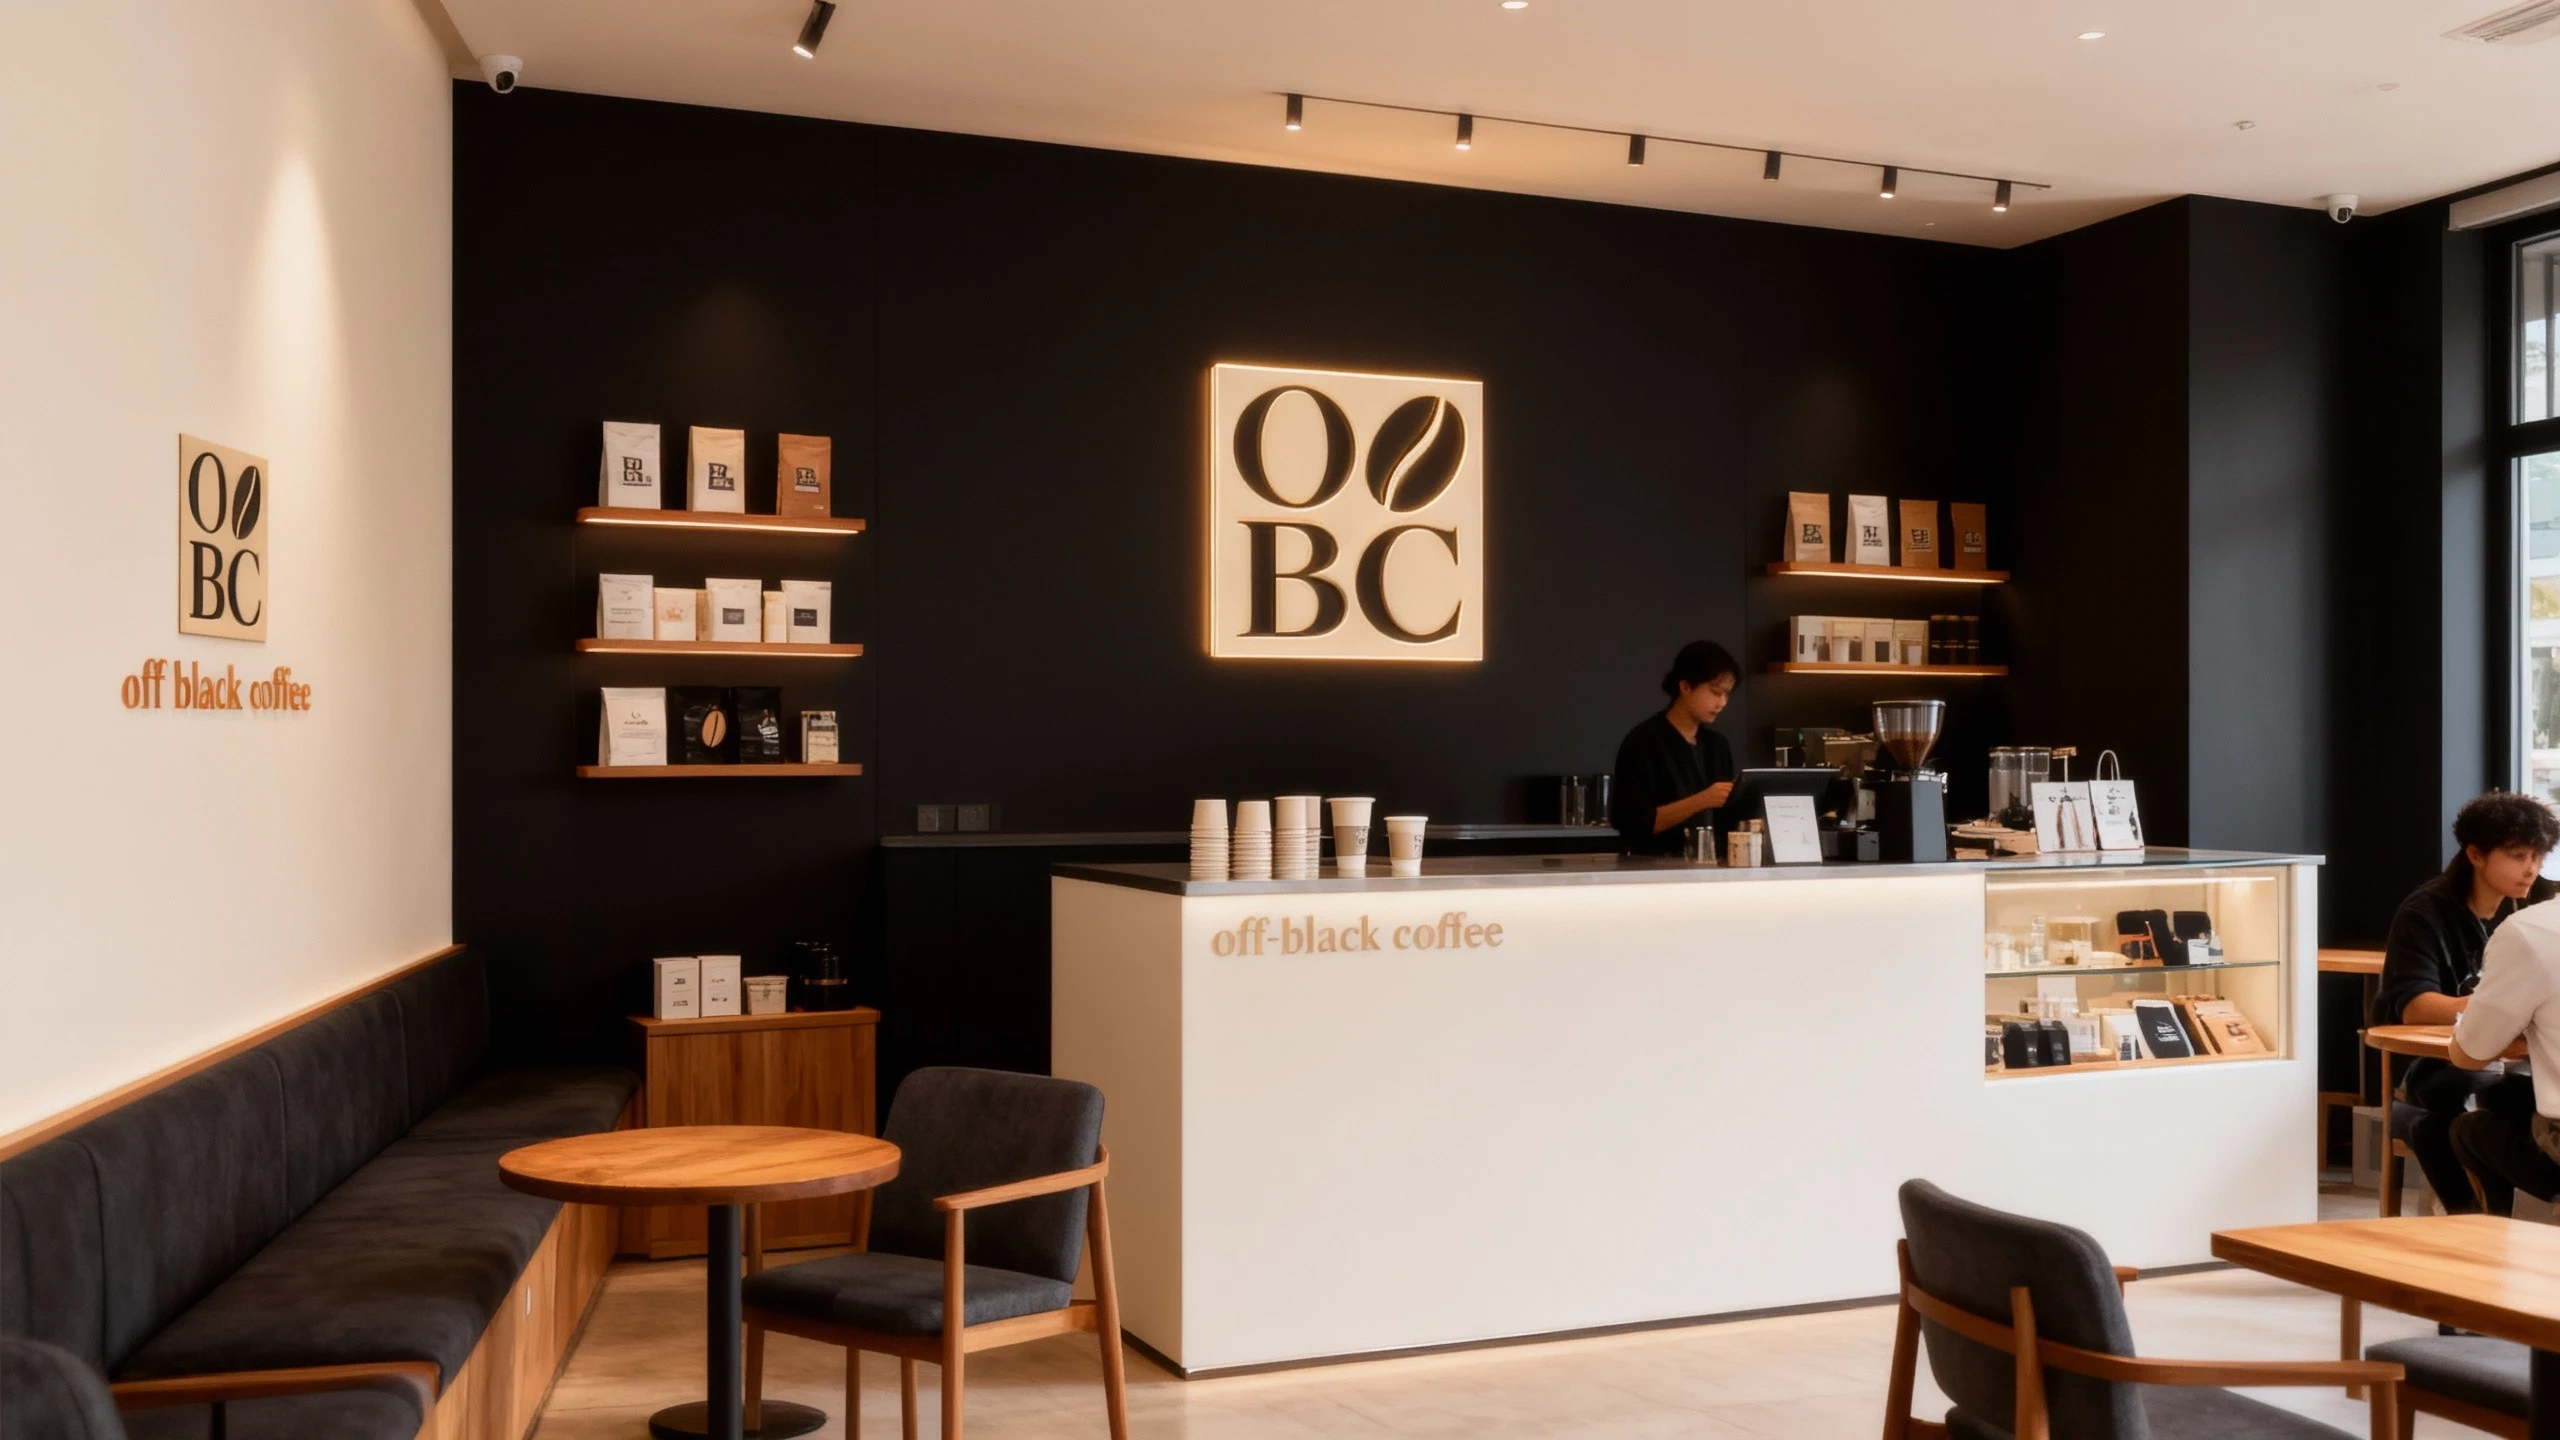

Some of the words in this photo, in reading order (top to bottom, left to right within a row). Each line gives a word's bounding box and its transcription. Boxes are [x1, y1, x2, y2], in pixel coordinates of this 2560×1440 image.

[1232, 384, 1356, 509] O
[188, 451, 227, 534] O
[189, 540, 261, 627] BC
[1236, 520, 1463, 644] BC
[121, 657, 168, 711] off
[173, 660, 243, 711] black
[1210, 914, 1382, 957] off-black
[1392, 911, 1504, 951] coffee
